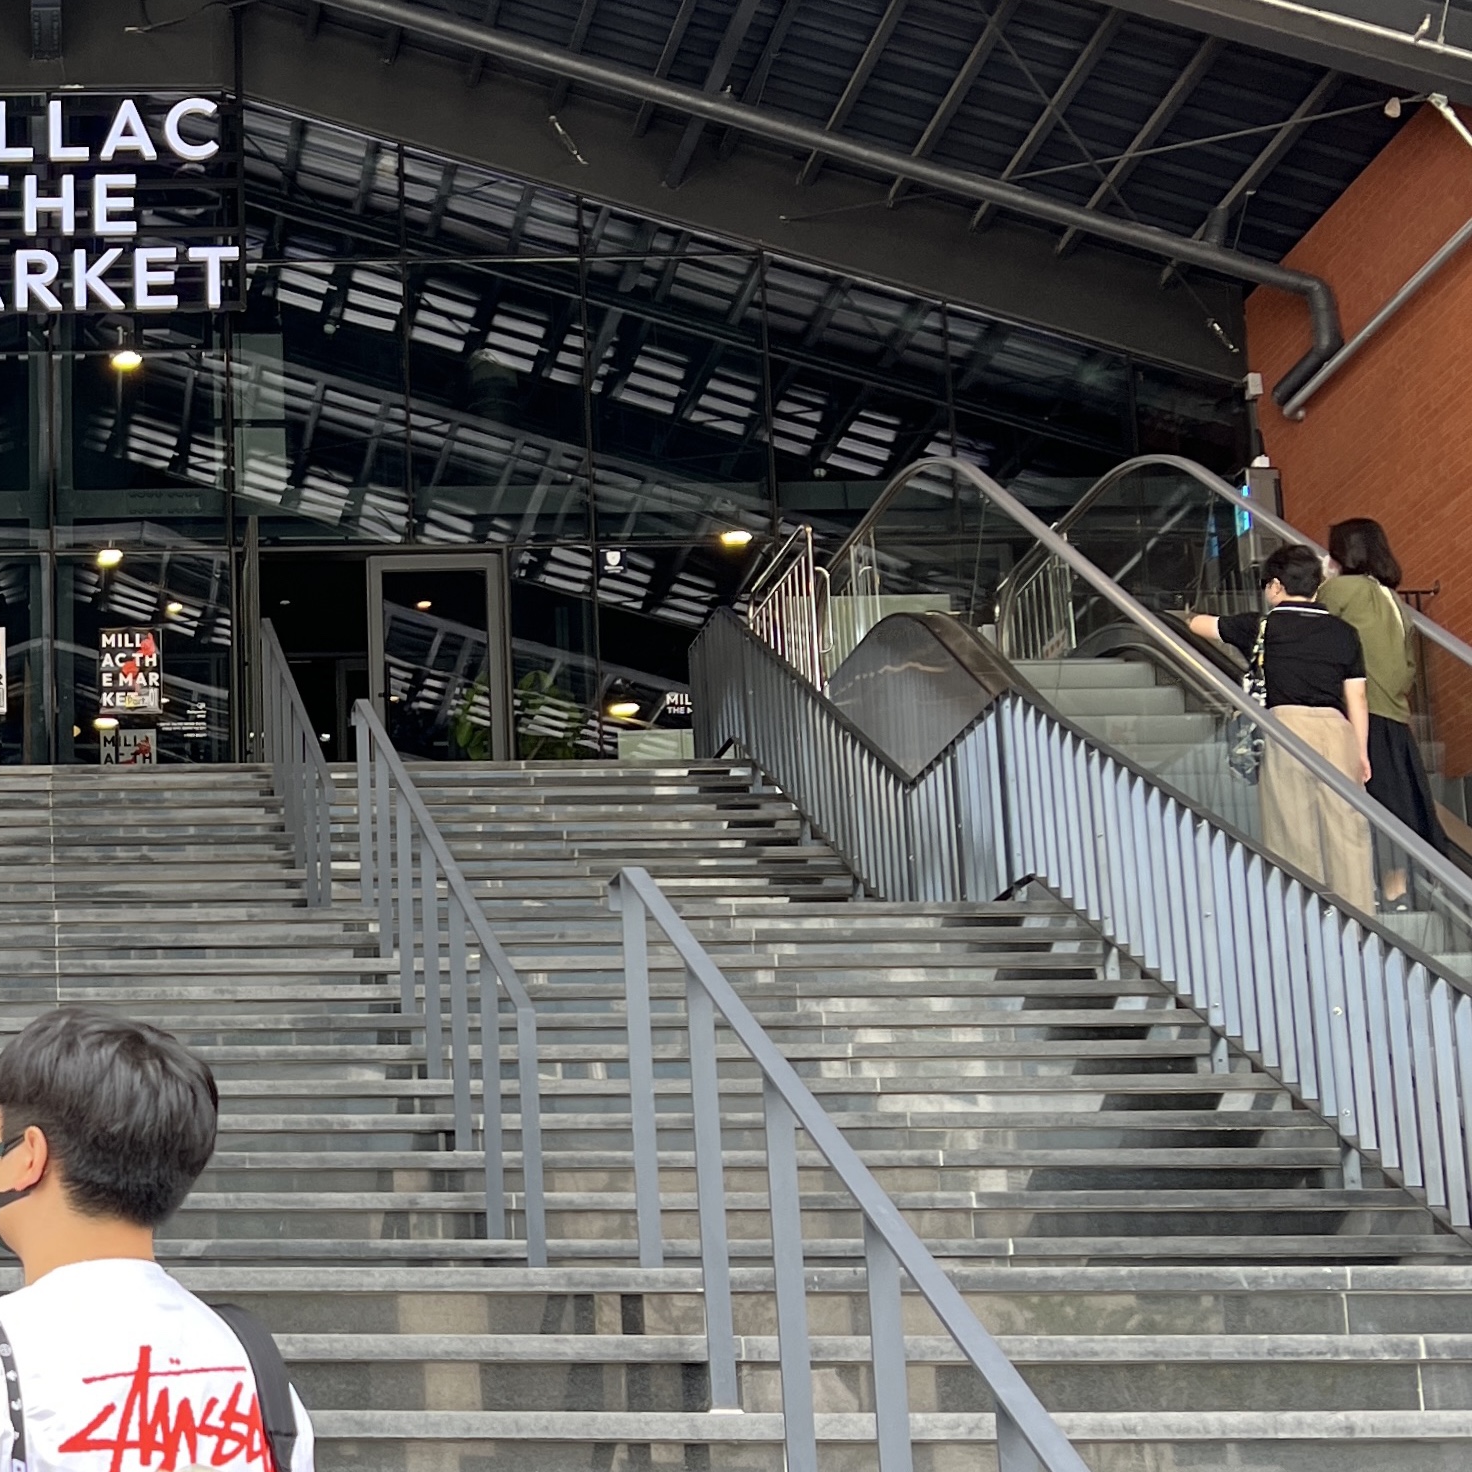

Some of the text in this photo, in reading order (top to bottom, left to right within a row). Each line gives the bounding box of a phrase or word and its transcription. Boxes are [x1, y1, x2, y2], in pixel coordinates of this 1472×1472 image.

[101, 633, 142, 648] MILL
[101, 652, 157, 668] AC TH
[101, 672, 160, 687] E MAR
[666, 706, 685, 715] THE
